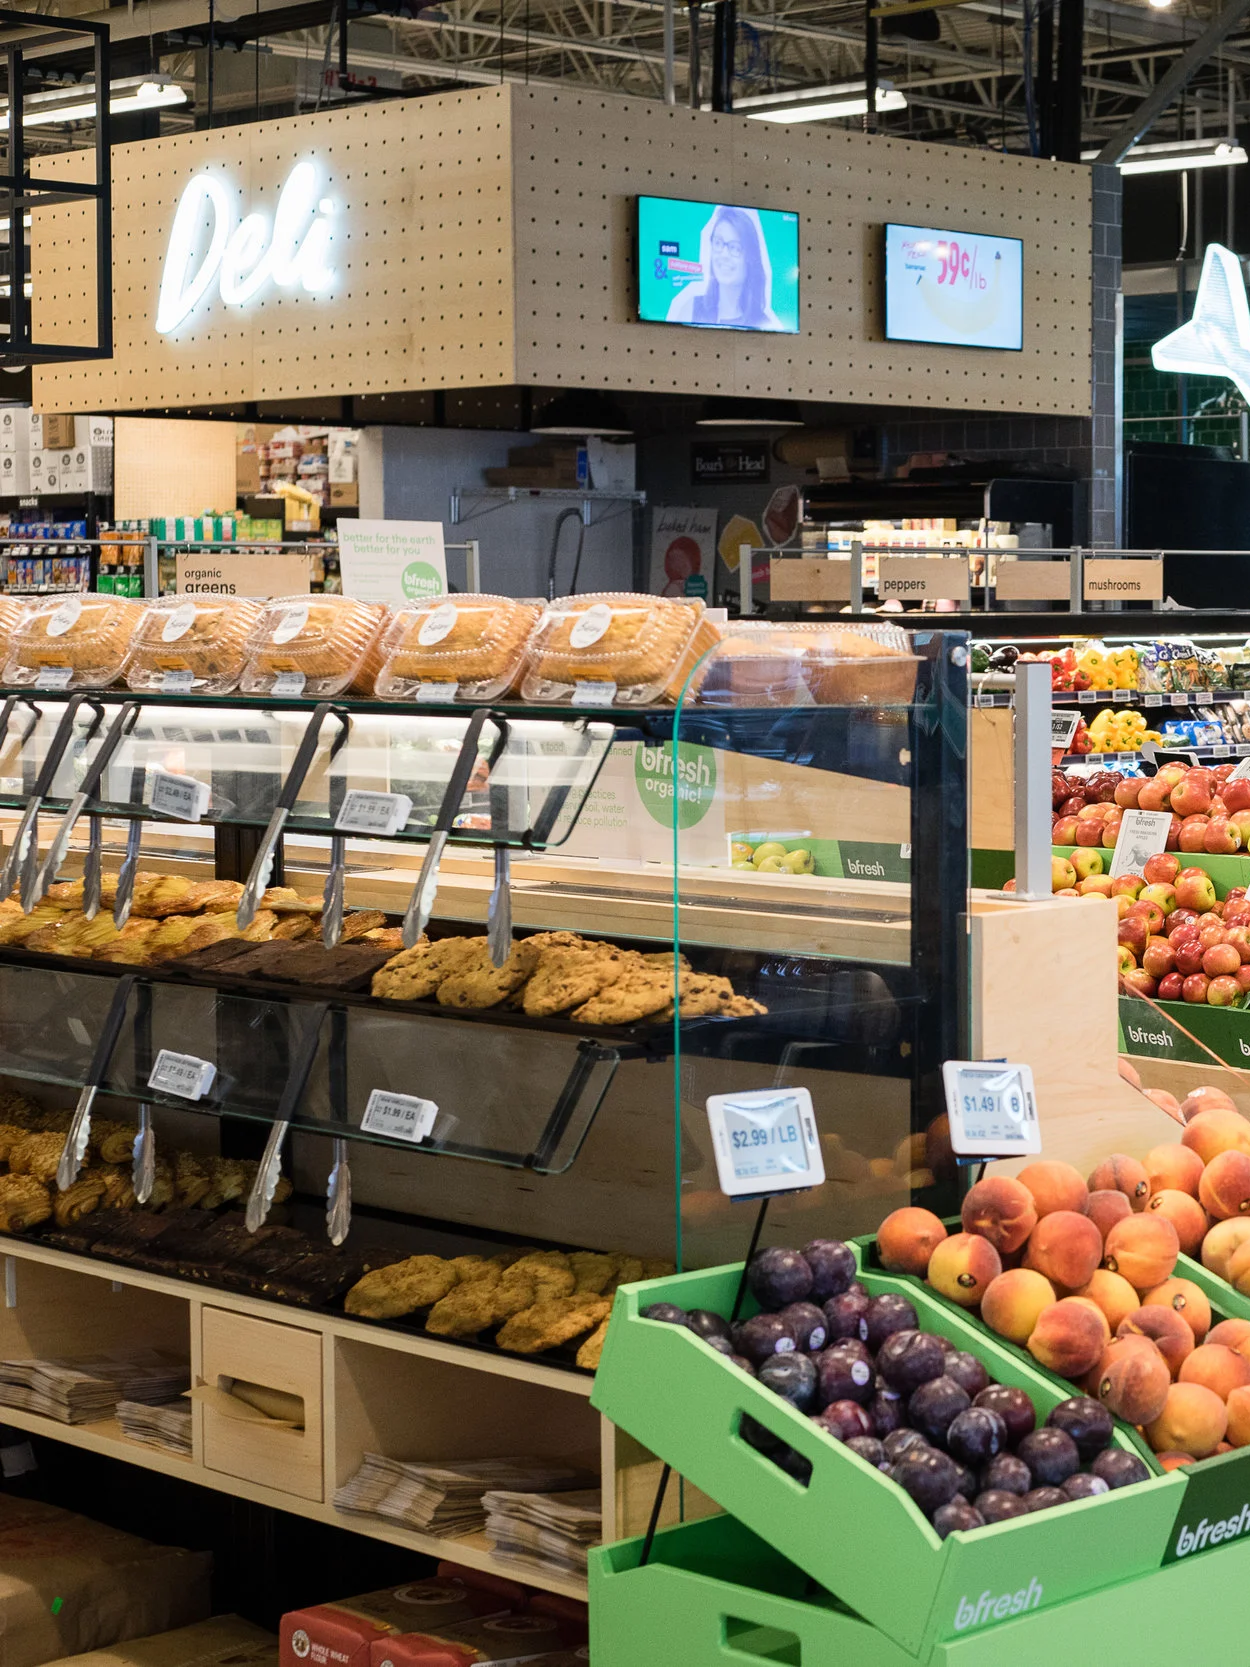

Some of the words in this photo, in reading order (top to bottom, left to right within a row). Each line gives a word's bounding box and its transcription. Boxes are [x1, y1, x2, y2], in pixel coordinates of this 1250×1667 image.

[155, 160, 336, 334] Deli
[738, 455, 765, 470] Head
[343, 532, 373, 543] better
[375, 532, 390, 544] for
[392, 534, 408, 544] the
[410, 535, 436, 545] earth
[353, 544, 384, 554] better
[386, 544, 400, 554] for
[403, 547, 421, 556] you
[184, 567, 222, 581] organic
[404, 571, 440, 591] bfresh
[185, 582, 236, 595] greens
[883, 579, 926, 592] peppers
[1088, 578, 1141, 591] mushrooms
[641, 747, 711, 786] bfresh
[645, 778, 702, 804] organic!
[602, 805, 625, 814] water
[563, 815, 592, 826] reuce
[593, 815, 628, 828] pollution
[1135, 817, 1156, 827] bfresh
[847, 858, 885, 877] bfresh
[1128, 1026, 1173, 1047] bfresh
[963, 1095, 995, 1113] $1.49
[405, 1110, 416, 1120] EA
[731, 1128, 768, 1149] $2.99
[779, 1125, 798, 1143] LB
[953, 1576, 1043, 1631] bfresh
[310, 1652, 327, 1665] FLOUR
[311, 1643, 329, 1656] WHOLE
[330, 1650, 350, 1664] WHEAT
